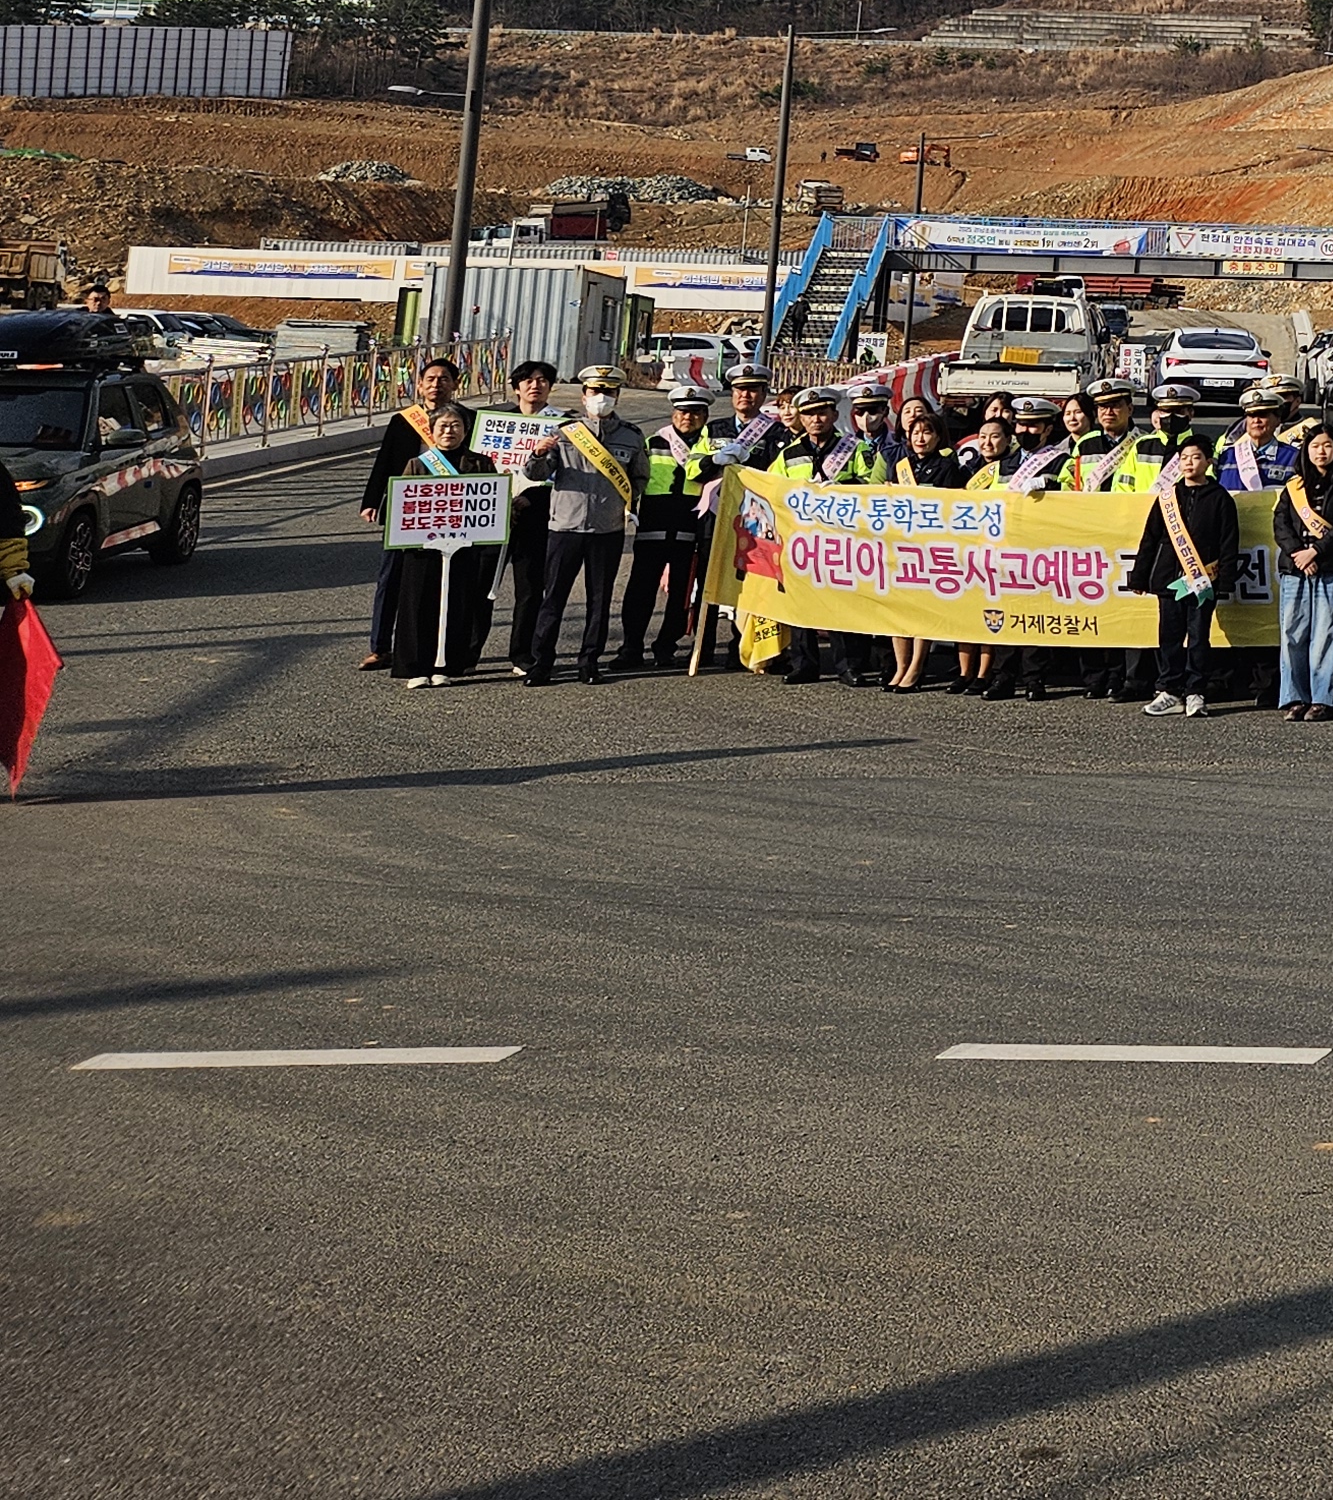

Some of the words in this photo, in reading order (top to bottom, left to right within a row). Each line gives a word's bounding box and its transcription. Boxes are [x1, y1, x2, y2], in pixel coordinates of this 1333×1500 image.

[485, 419, 516, 434] 안전을
[519, 422, 540, 436] 위해
[481, 435, 513, 450] 주행중
[788, 490, 861, 529] 안전한
[866, 498, 944, 533] 통학로
[951, 504, 1002, 536] 조성
[1164, 501, 1181, 534] 안전한
[791, 535, 885, 590] 어린이
[896, 546, 1108, 600] 교통사고예방
[1010, 613, 1099, 635] 거제경찰서
